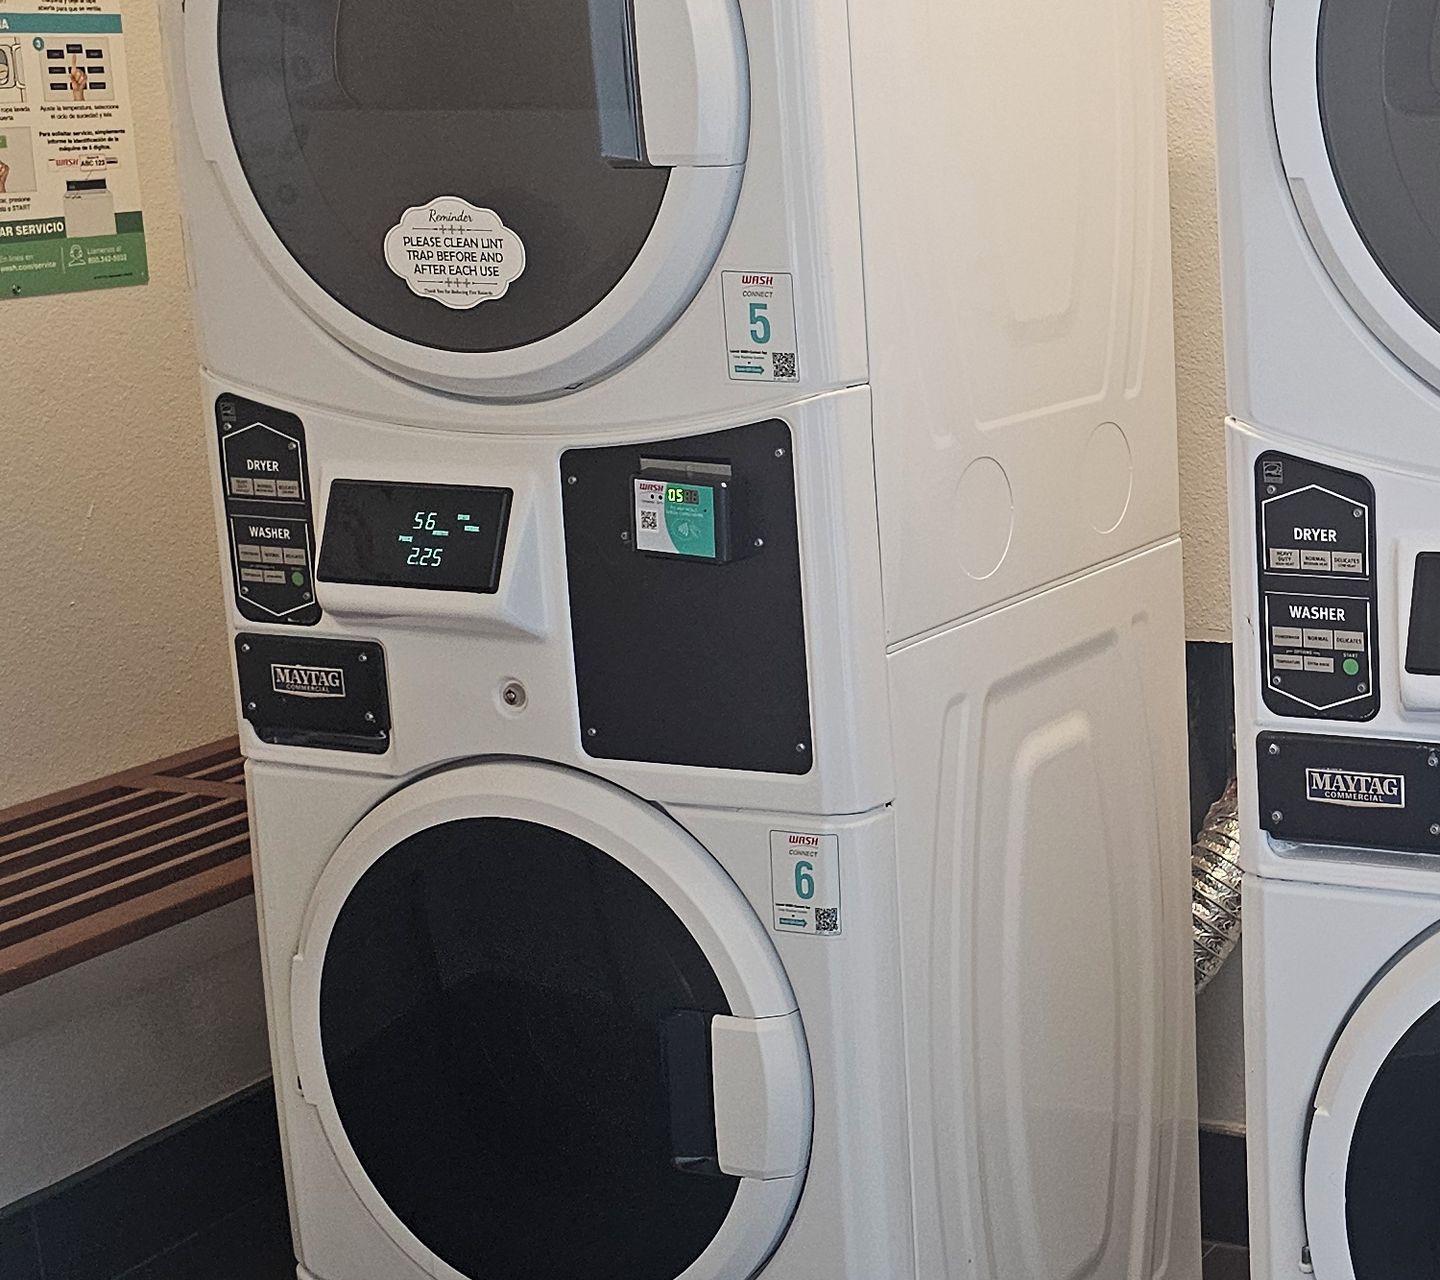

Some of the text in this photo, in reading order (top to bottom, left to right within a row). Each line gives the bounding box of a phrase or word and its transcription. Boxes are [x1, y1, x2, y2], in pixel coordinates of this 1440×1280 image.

[429, 209, 473, 222] Reminder
[16, 222, 64, 236] SERVICIO
[403, 237, 503, 249] PLEASE CLEAN LINT
[407, 250, 503, 263] TRAP BEFORE AND
[414, 264, 499, 277] AFTER EACH USE
[742, 275, 773, 285] WASH
[743, 290, 773, 298] CONNECT
[749, 303, 770, 344] 5
[247, 459, 280, 473] DRYER
[640, 483, 664, 492] WASH
[668, 489, 684, 503] 05
[411, 512, 437, 530] 56
[248, 525, 291, 540] WASHER
[1293, 527, 1337, 542] DRYER
[406, 547, 443, 566] 2.25
[1289, 605, 1345, 621] WASHER
[1336, 637, 1362, 645] DELICATES
[275, 667, 341, 687] MAYTAG
[1311, 773, 1398, 796] MAYTAG
[1325, 790, 1384, 802] COMMERCIAL
[789, 835, 819, 846] WASH
[789, 849, 818, 857] CONNECT
[795, 860, 815, 900] 6
